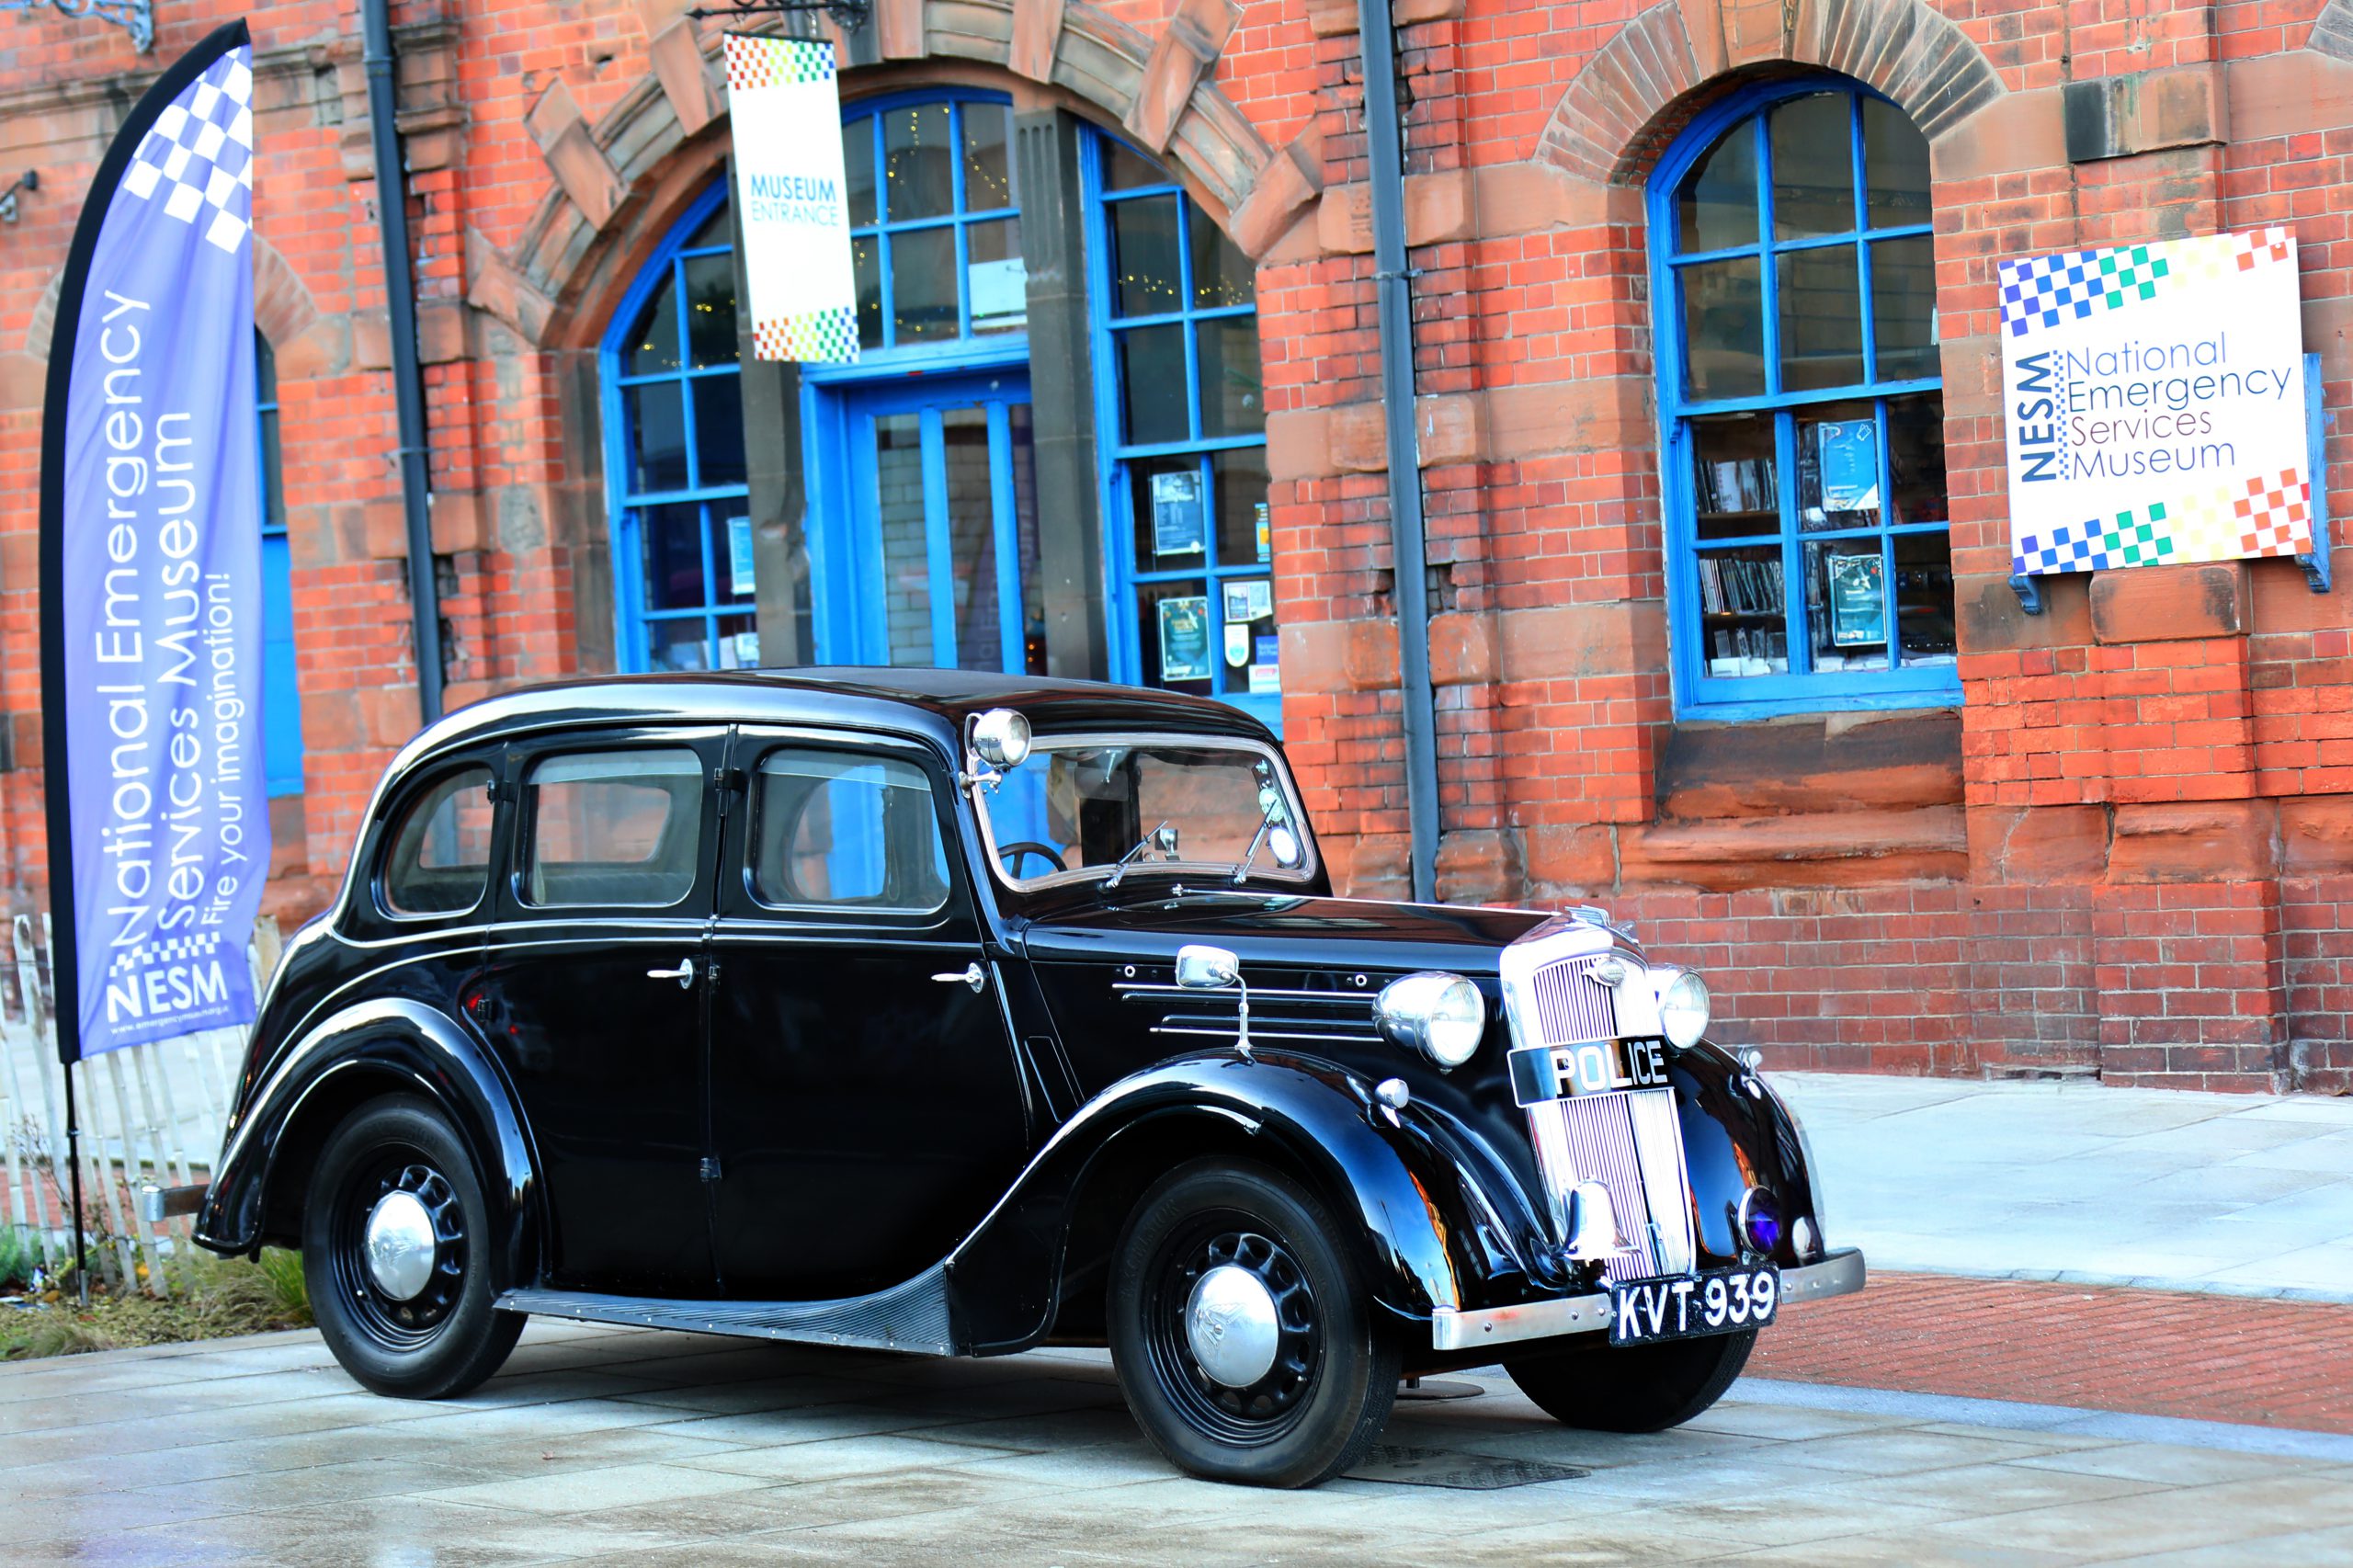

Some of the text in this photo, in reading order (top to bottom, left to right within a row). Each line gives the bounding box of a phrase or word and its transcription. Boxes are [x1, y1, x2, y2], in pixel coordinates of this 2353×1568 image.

[751, 175, 835, 201] MUSEUM
[752, 201, 838, 226] ENTRANCE
[2066, 331, 2226, 379] National
[2015, 351, 2057, 483] NESM
[2068, 367, 2291, 413] Emergency
[2071, 409, 2212, 447] Services
[2073, 442, 2235, 481] Museum
[95, 289, 153, 948] National Emergency
[153, 411, 204, 931] Services Museum
[201, 572, 248, 926] Fire your imagination!
[106, 960, 229, 1023] NESM
[1549, 1040, 1668, 1095] POLICE
[1619, 1270, 1775, 1340] KVT 939
